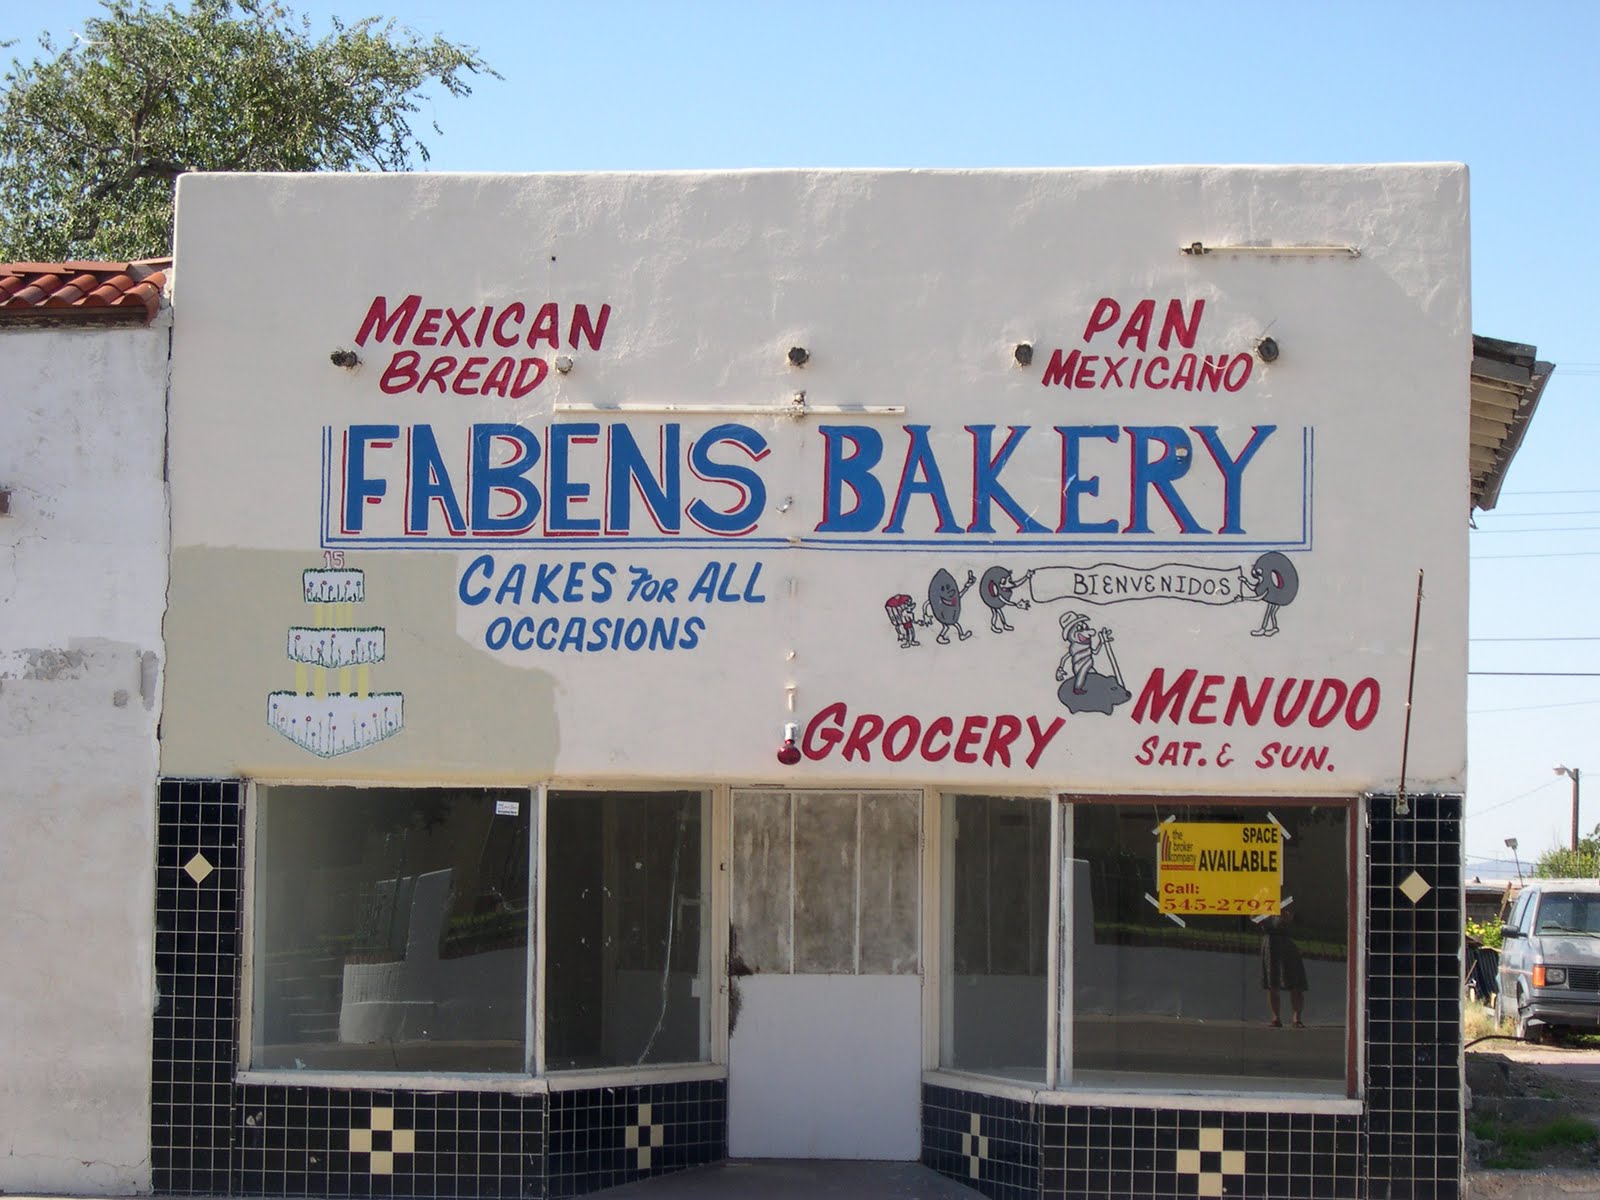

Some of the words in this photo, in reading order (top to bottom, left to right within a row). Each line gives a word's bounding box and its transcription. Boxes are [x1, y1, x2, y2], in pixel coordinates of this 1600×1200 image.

[355, 295, 611, 351] MEXICAN
[1083, 297, 1205, 351] PAN
[379, 350, 548, 399] BREAD
[1042, 349, 1253, 392] MEXICANO
[341, 423, 771, 537] FABENS
[814, 424, 1277, 535] BAKERY
[323, 550, 345, 569] 15
[459, 555, 616, 606] CAKES
[688, 561, 766, 603] ALL
[1073, 573, 1232, 597] BIENVENIDOS
[485, 617, 706, 652] OCCASIONS
[1130, 667, 1381, 731] MENUDO
[801, 702, 1066, 769] GROCERY
[1135, 736, 1207, 766] SAT.
[1255, 741, 1336, 771] SUN.
[1172, 829, 1183, 840] the
[1173, 842, 1193, 852] broker
[1242, 827, 1278, 844] SPACE
[1169, 853, 1196, 865] company
[1198, 850, 1277, 872] AVAILABLE
[1164, 883, 1200, 895] Call:
[1164, 898, 1276, 911] 545-2797
